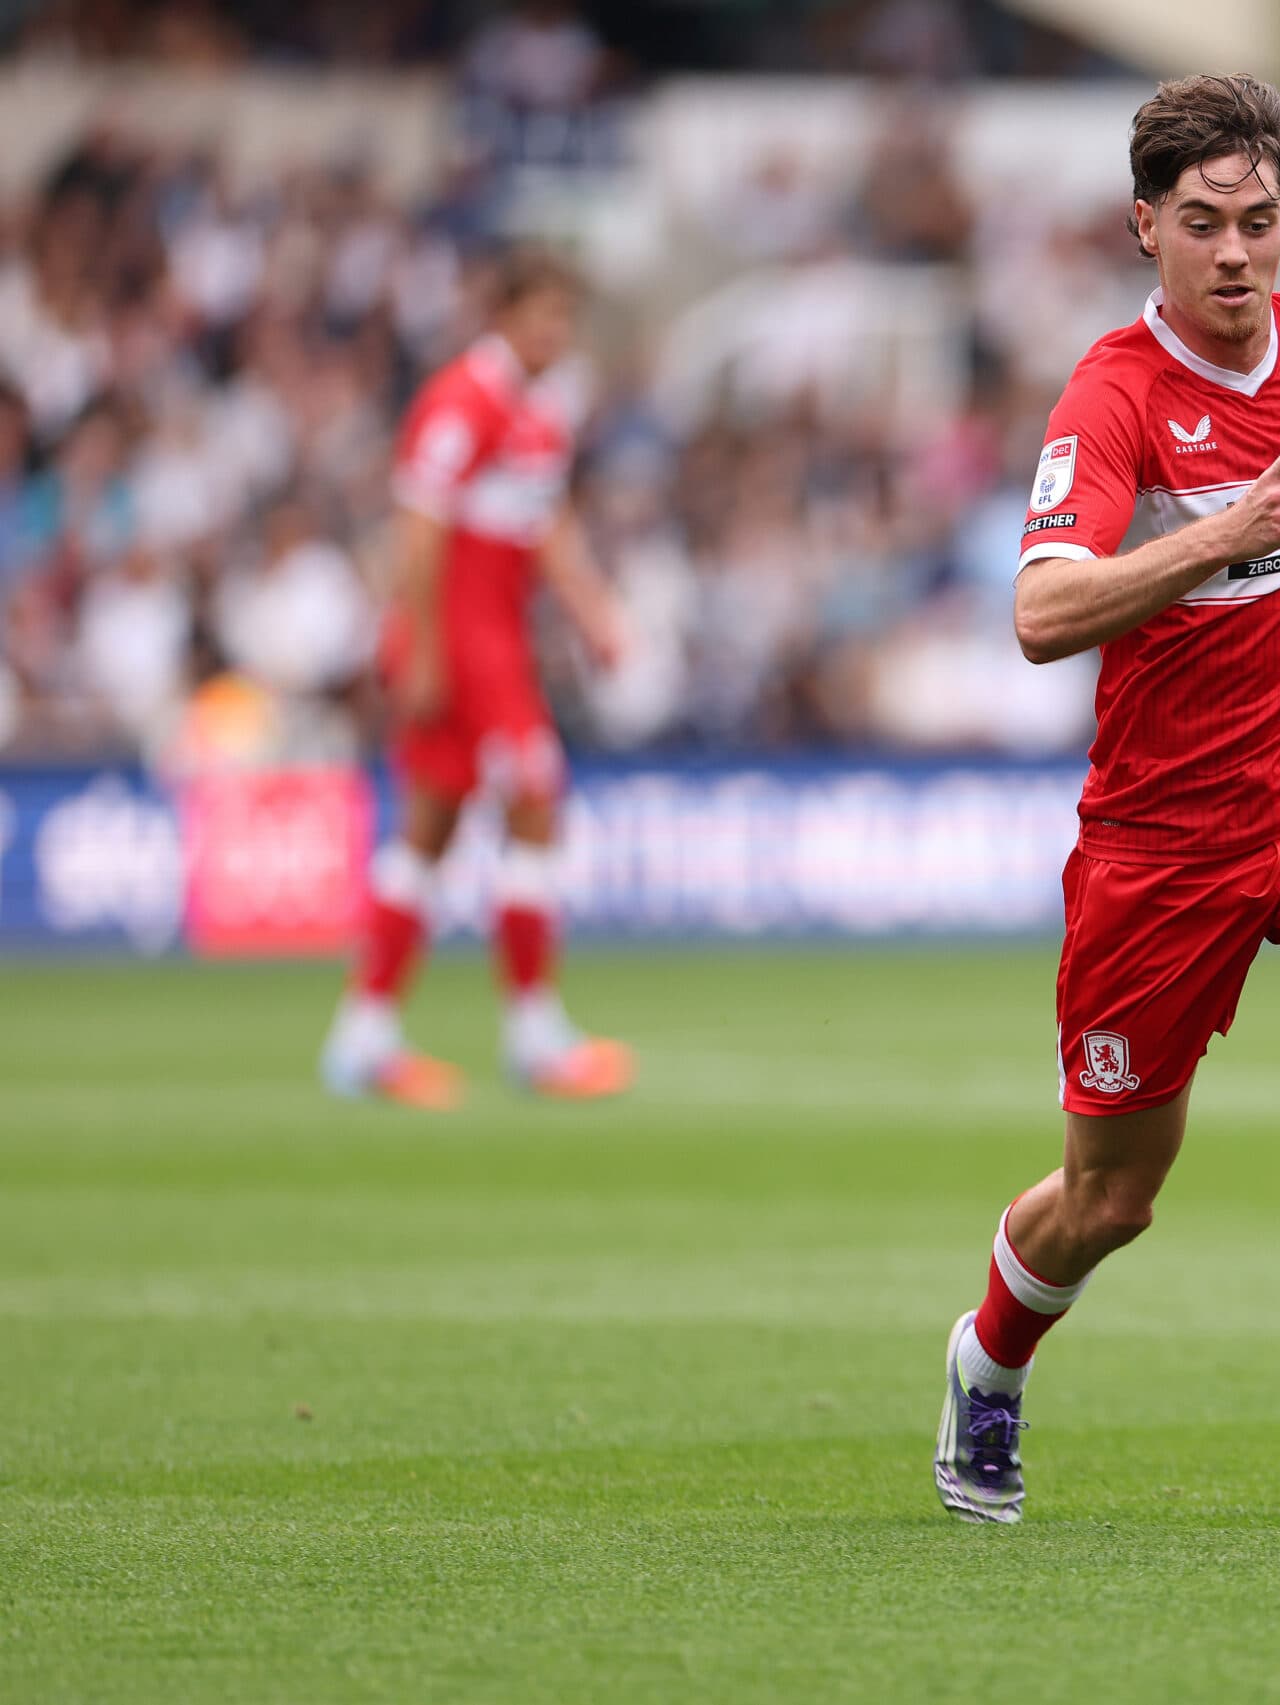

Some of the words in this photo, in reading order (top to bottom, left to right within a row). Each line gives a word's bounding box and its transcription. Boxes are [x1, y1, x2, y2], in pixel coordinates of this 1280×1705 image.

[1052, 446, 1070, 457] bet
[1175, 442, 1218, 454] CASTORE
[1038, 494, 1052, 505] EFL
[1025, 514, 1075, 534] GETHER
